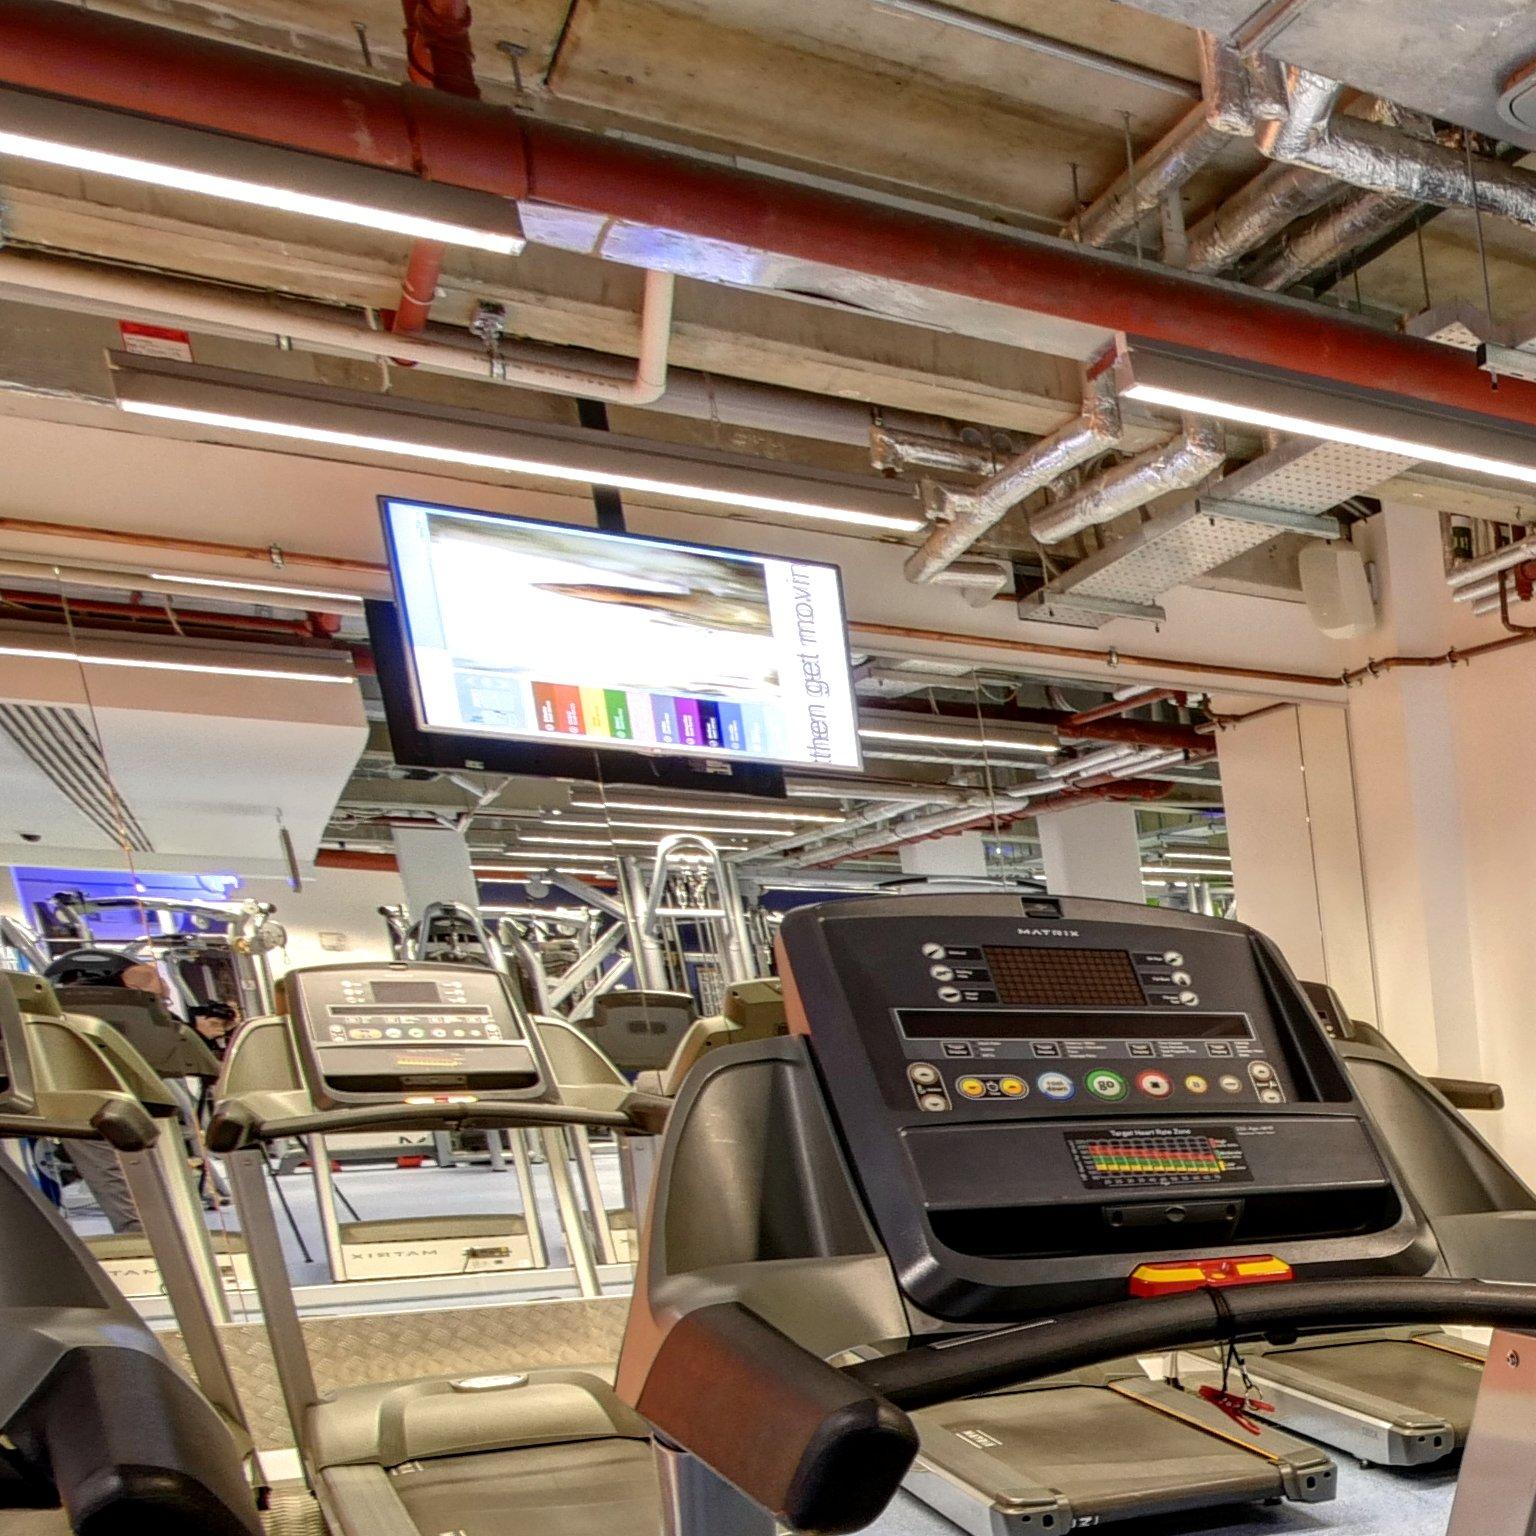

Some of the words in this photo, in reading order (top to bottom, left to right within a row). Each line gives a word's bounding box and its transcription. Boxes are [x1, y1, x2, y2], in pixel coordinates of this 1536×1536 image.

[797, 652, 830, 697] get
[807, 704, 831, 762] then
[1017, 928, 1080, 937] MATRIX
[1098, 1080, 1115, 1092] go
